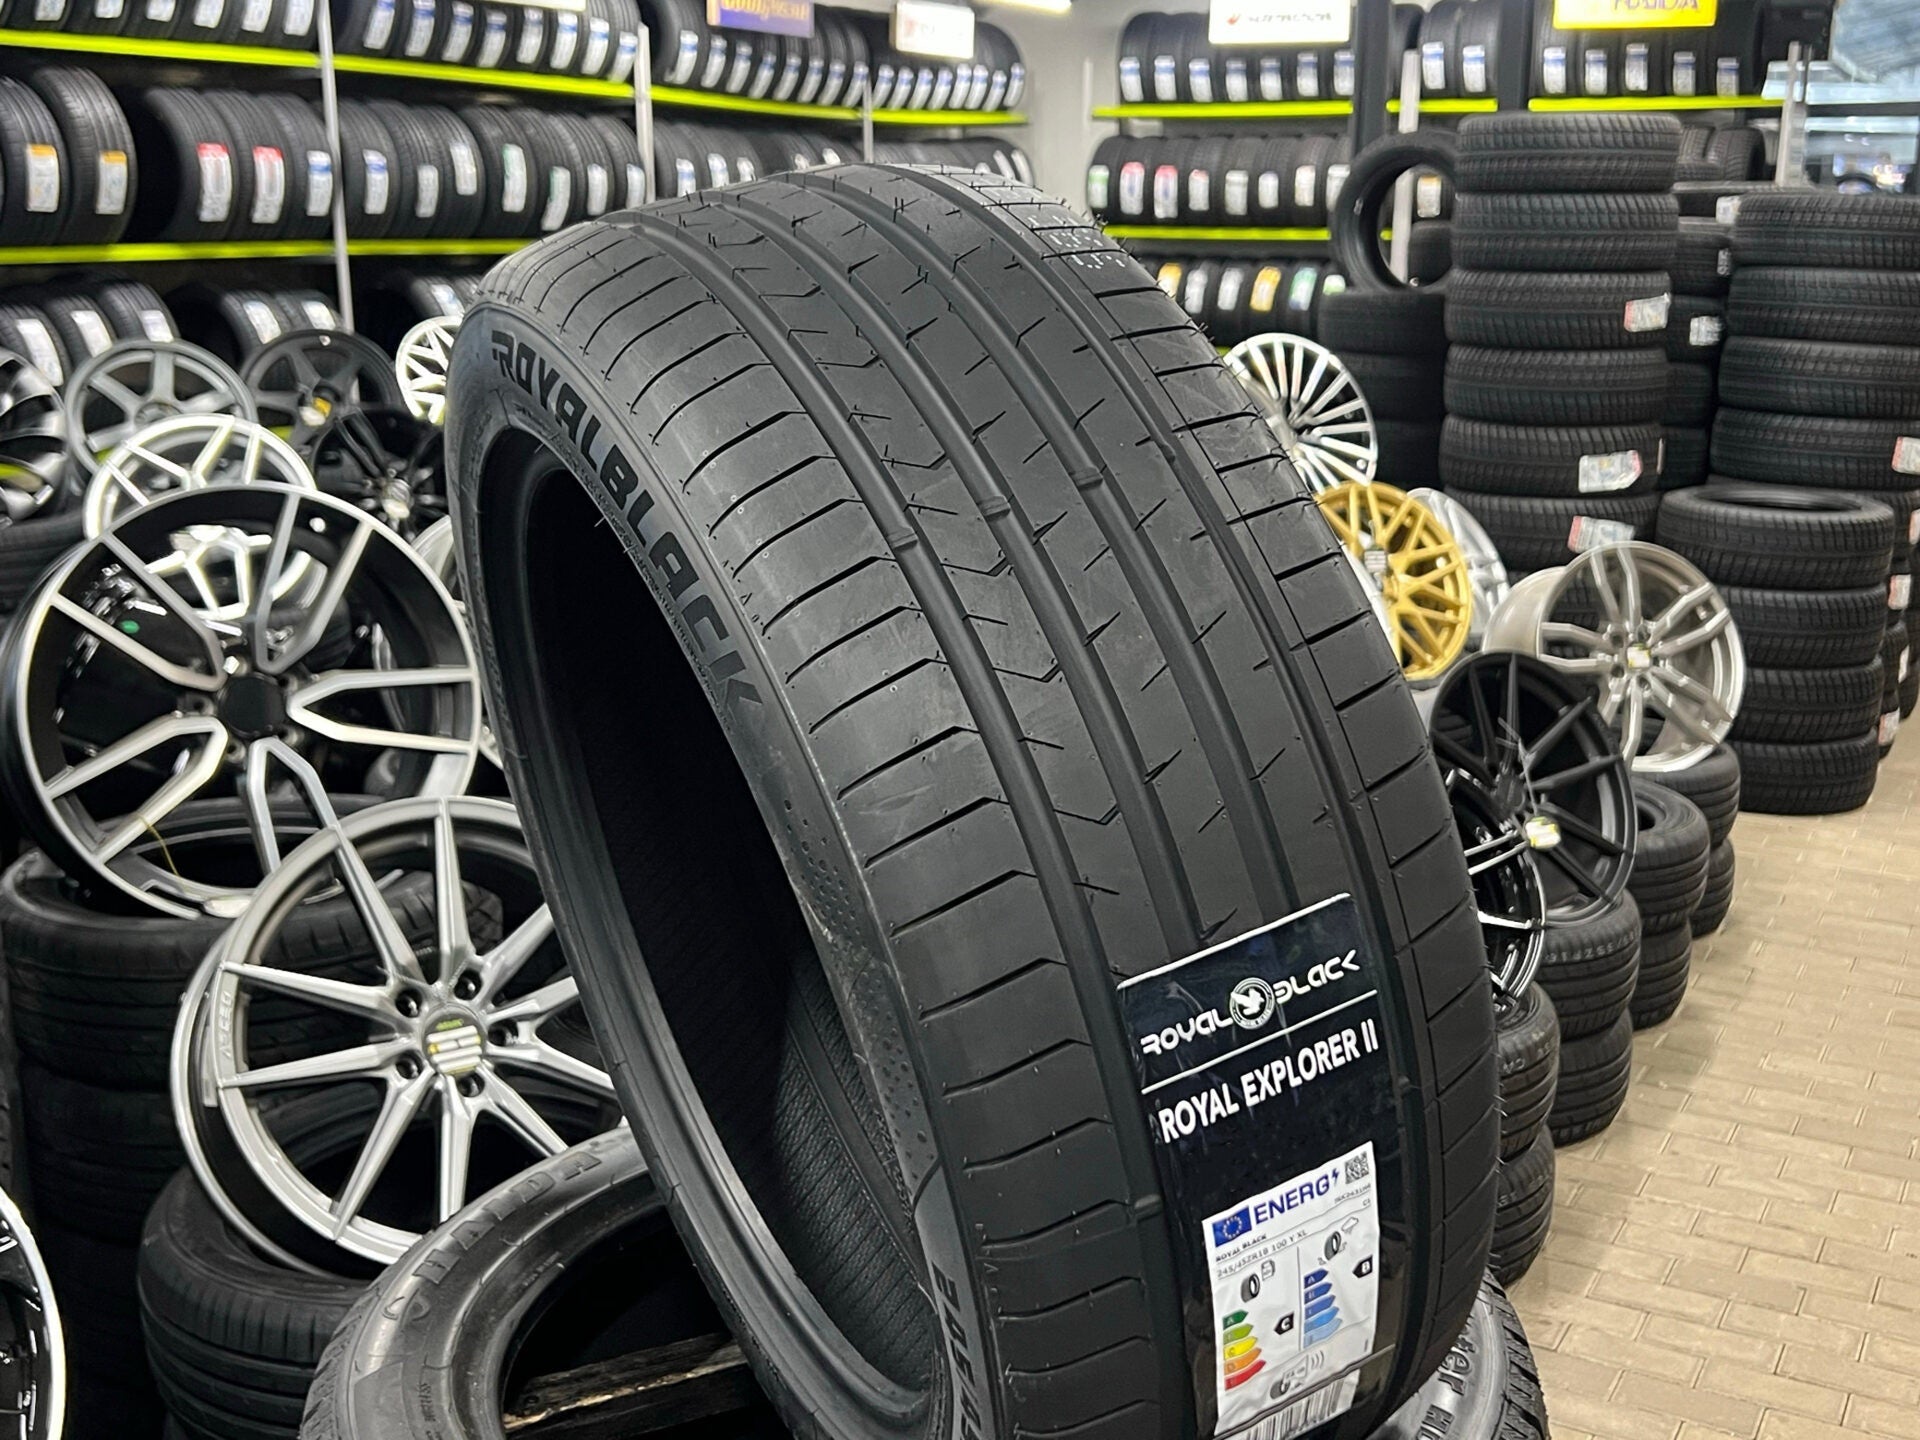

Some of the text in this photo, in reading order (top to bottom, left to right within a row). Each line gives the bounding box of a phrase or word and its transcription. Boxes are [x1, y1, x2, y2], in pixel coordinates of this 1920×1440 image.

[1140, 949, 1360, 1055] ROYAL BLACK
[1158, 1018, 1379, 1143] ROYAL EXPLORER II
[412, 1151, 602, 1285] HAIDA
[1216, 1233, 1267, 1262] ROYAL BLACK
[1272, 1239, 1287, 1252] 100
